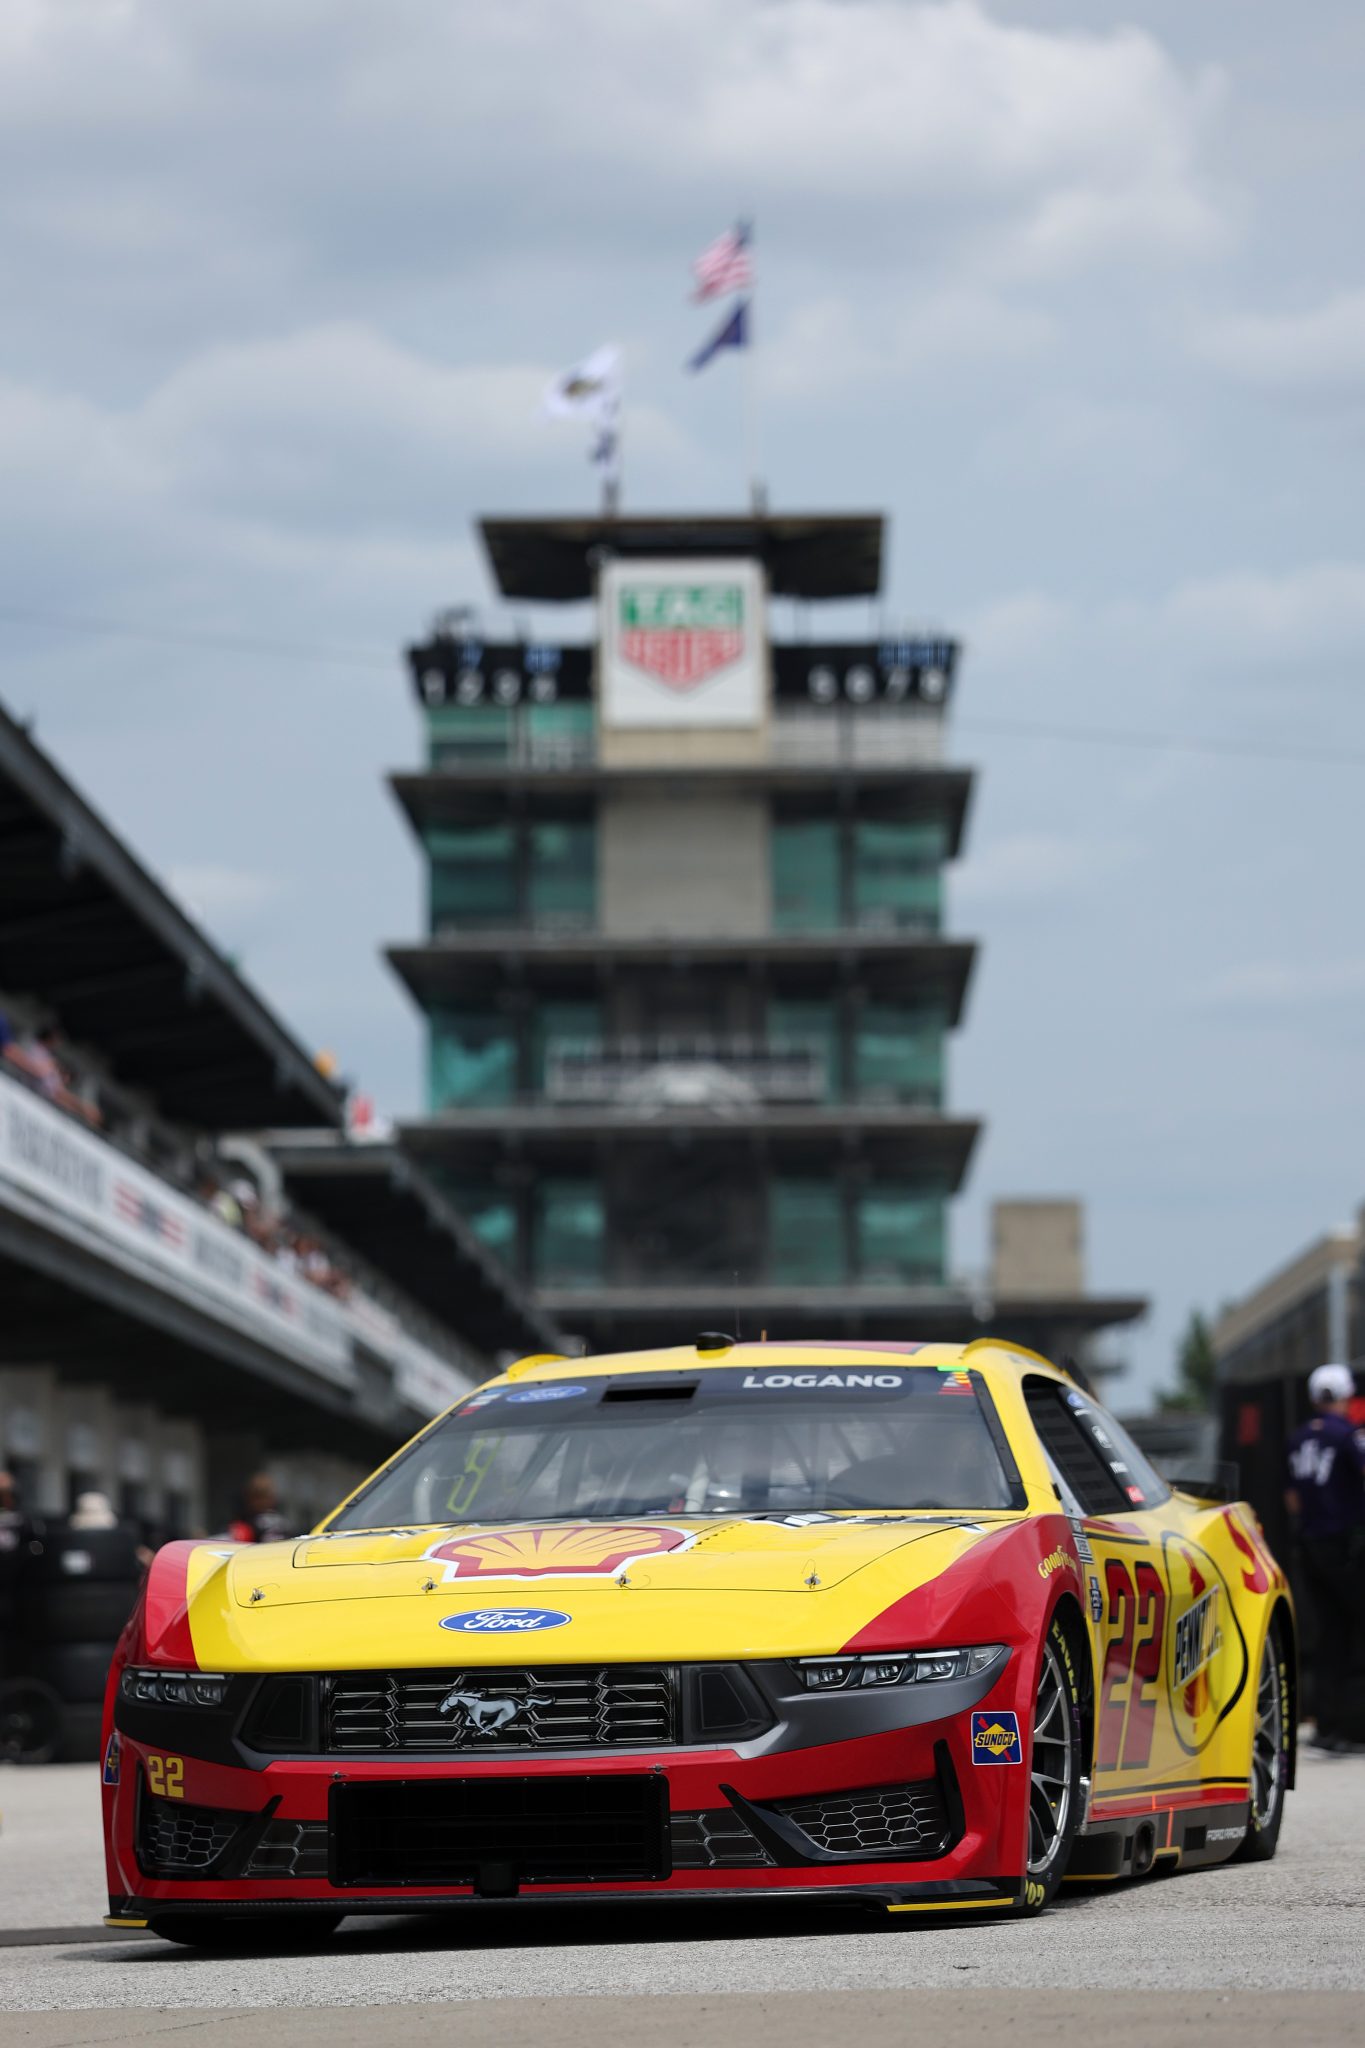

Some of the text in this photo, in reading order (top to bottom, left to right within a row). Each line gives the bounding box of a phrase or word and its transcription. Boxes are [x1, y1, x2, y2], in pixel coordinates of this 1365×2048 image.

[742, 1374, 903, 1389] LOGANO
[463, 1611, 547, 1629] Ford
[1096, 1558, 1166, 1773] 22
[976, 1733, 1014, 1746] SUNOCO
[148, 1755, 184, 1798] 22
